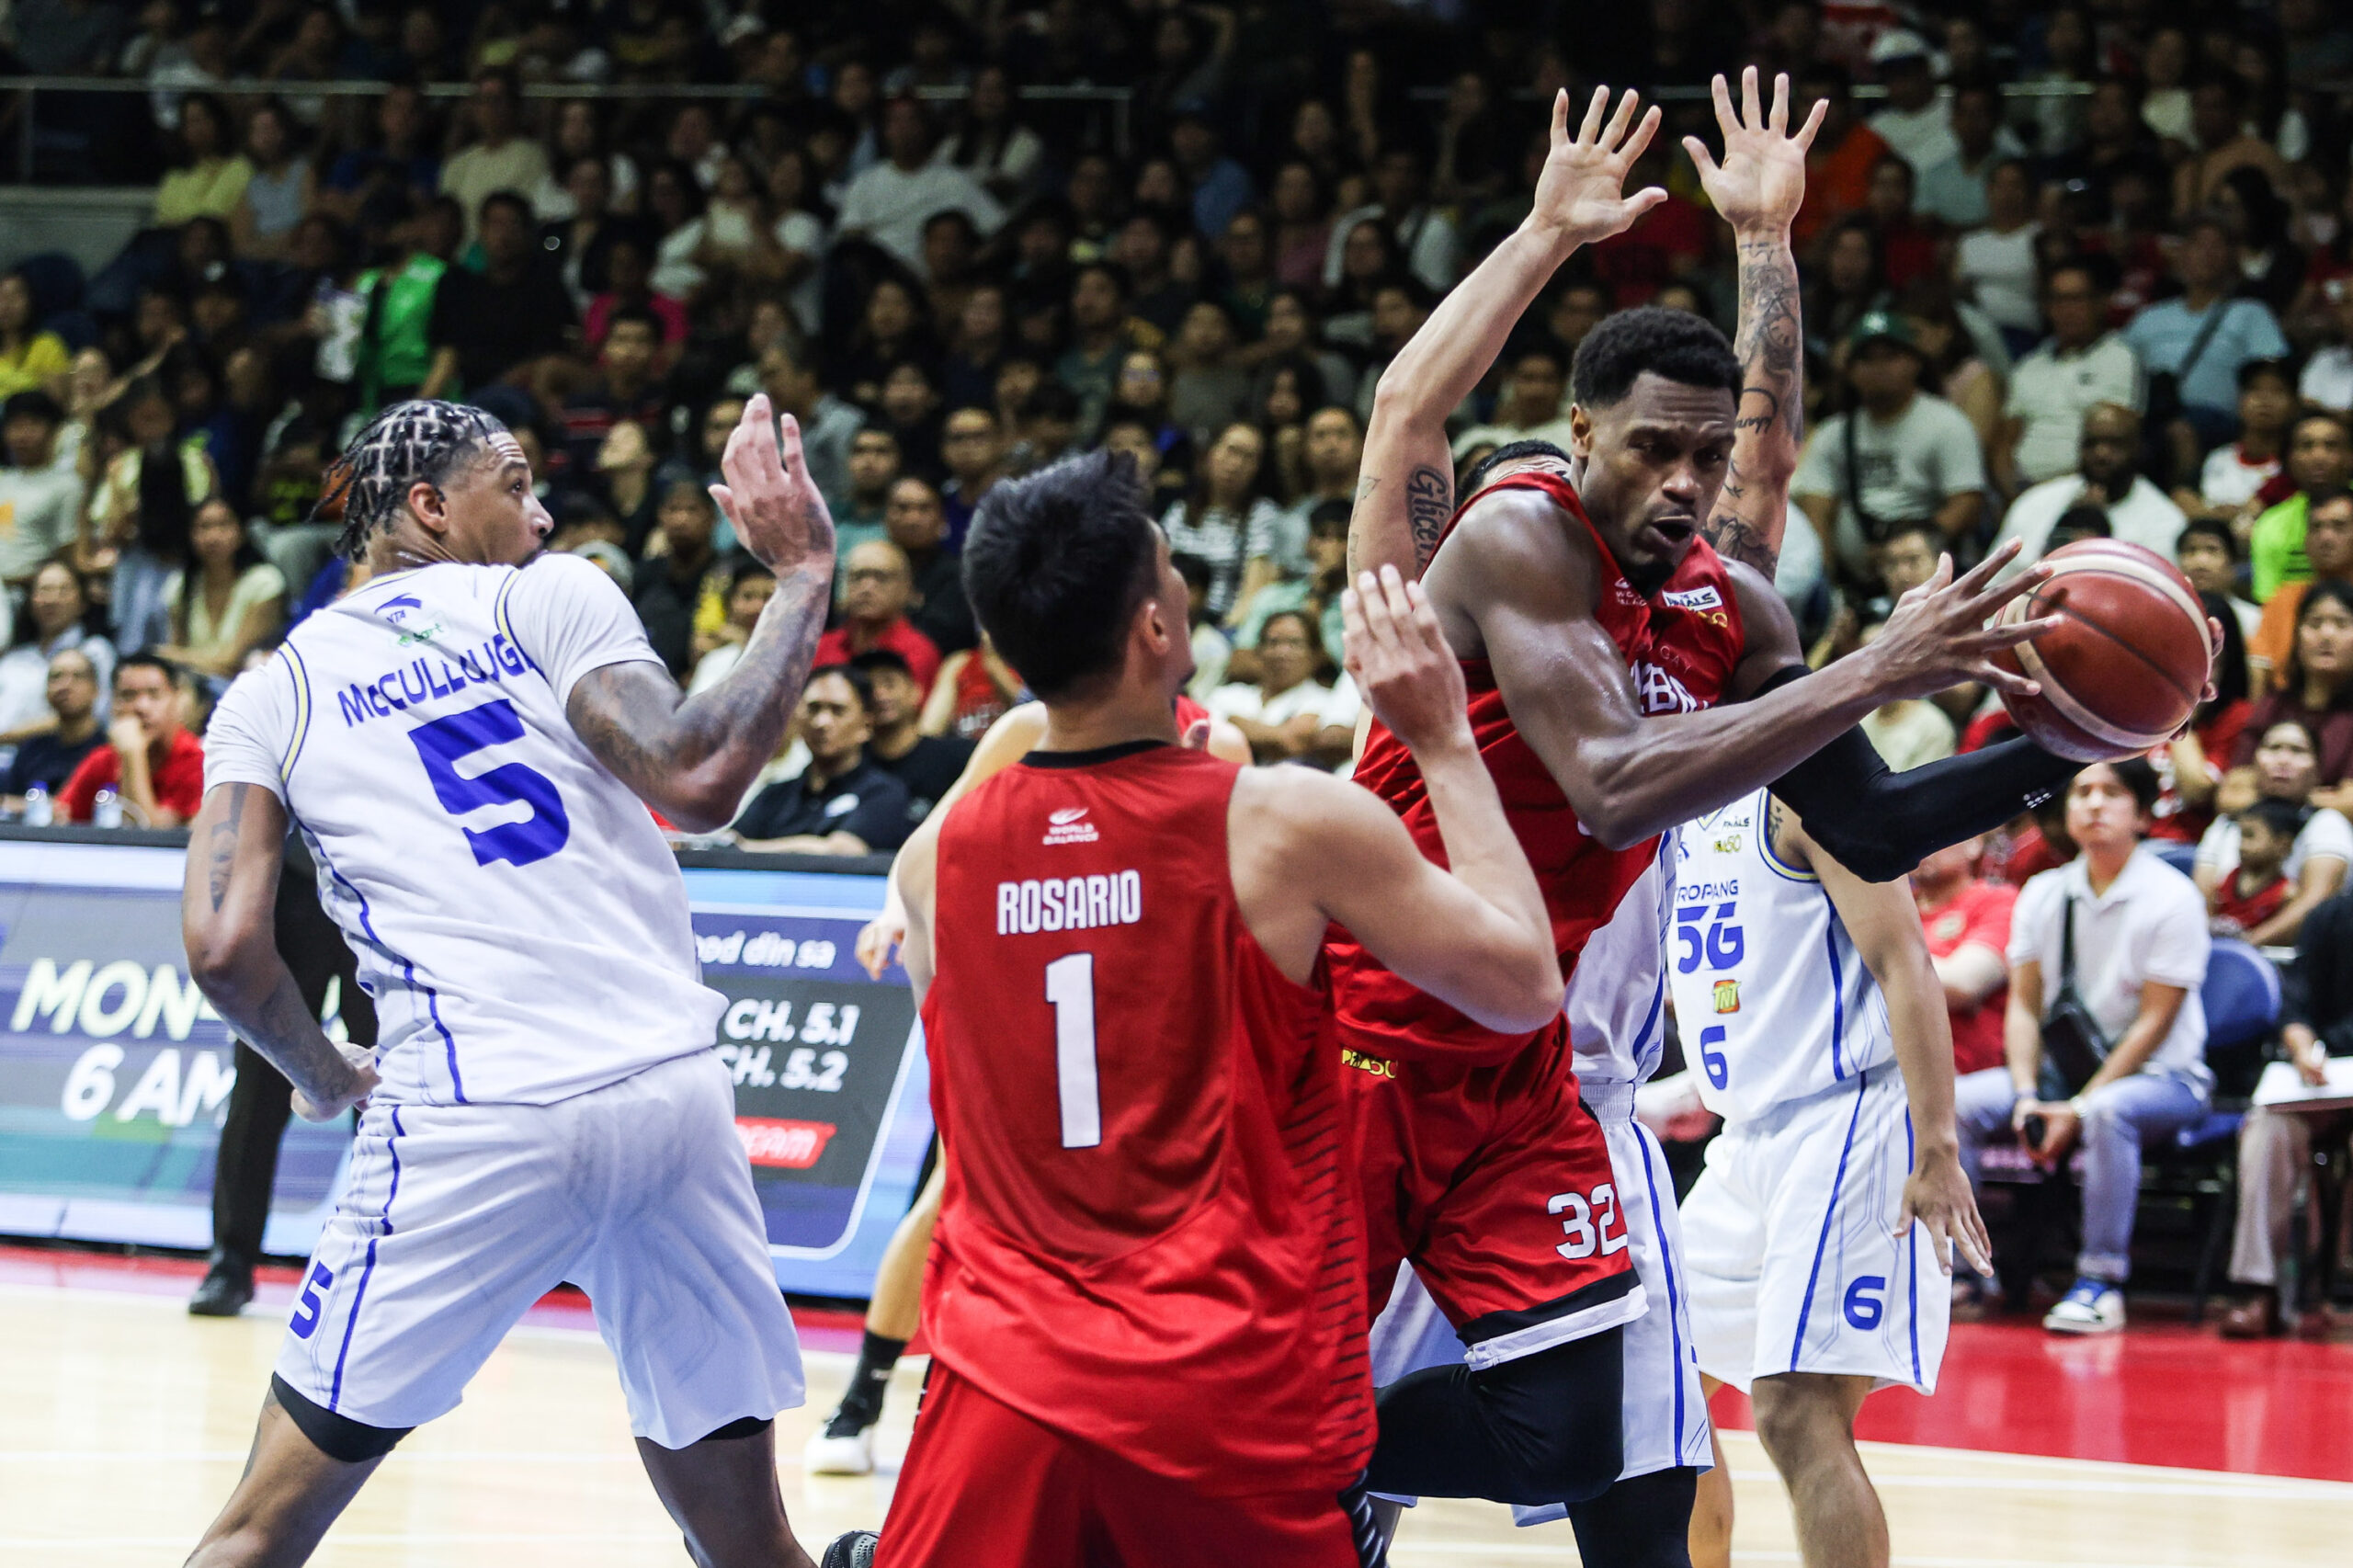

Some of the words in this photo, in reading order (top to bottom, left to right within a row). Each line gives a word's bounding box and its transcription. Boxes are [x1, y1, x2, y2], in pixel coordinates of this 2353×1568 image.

[337, 633, 534, 728] McCULLOUG
[407, 698, 570, 867] 5
[997, 869, 1142, 936] ROSARIO
[1677, 879, 1739, 902] ROPANG
[1677, 902, 1745, 974] 5G
[724, 999, 795, 1041] CH.
[800, 1002, 860, 1046] 5.1
[1713, 981, 1742, 1013] TNT
[62, 1043, 124, 1120] 6
[780, 1048, 848, 1092] 5.2
[1045, 951, 1101, 1149] 1
[1700, 1025, 1728, 1091] 6
[1546, 1182, 1629, 1260] 32
[290, 1259, 334, 1339] 5
[1844, 1276, 1886, 1331] 6
